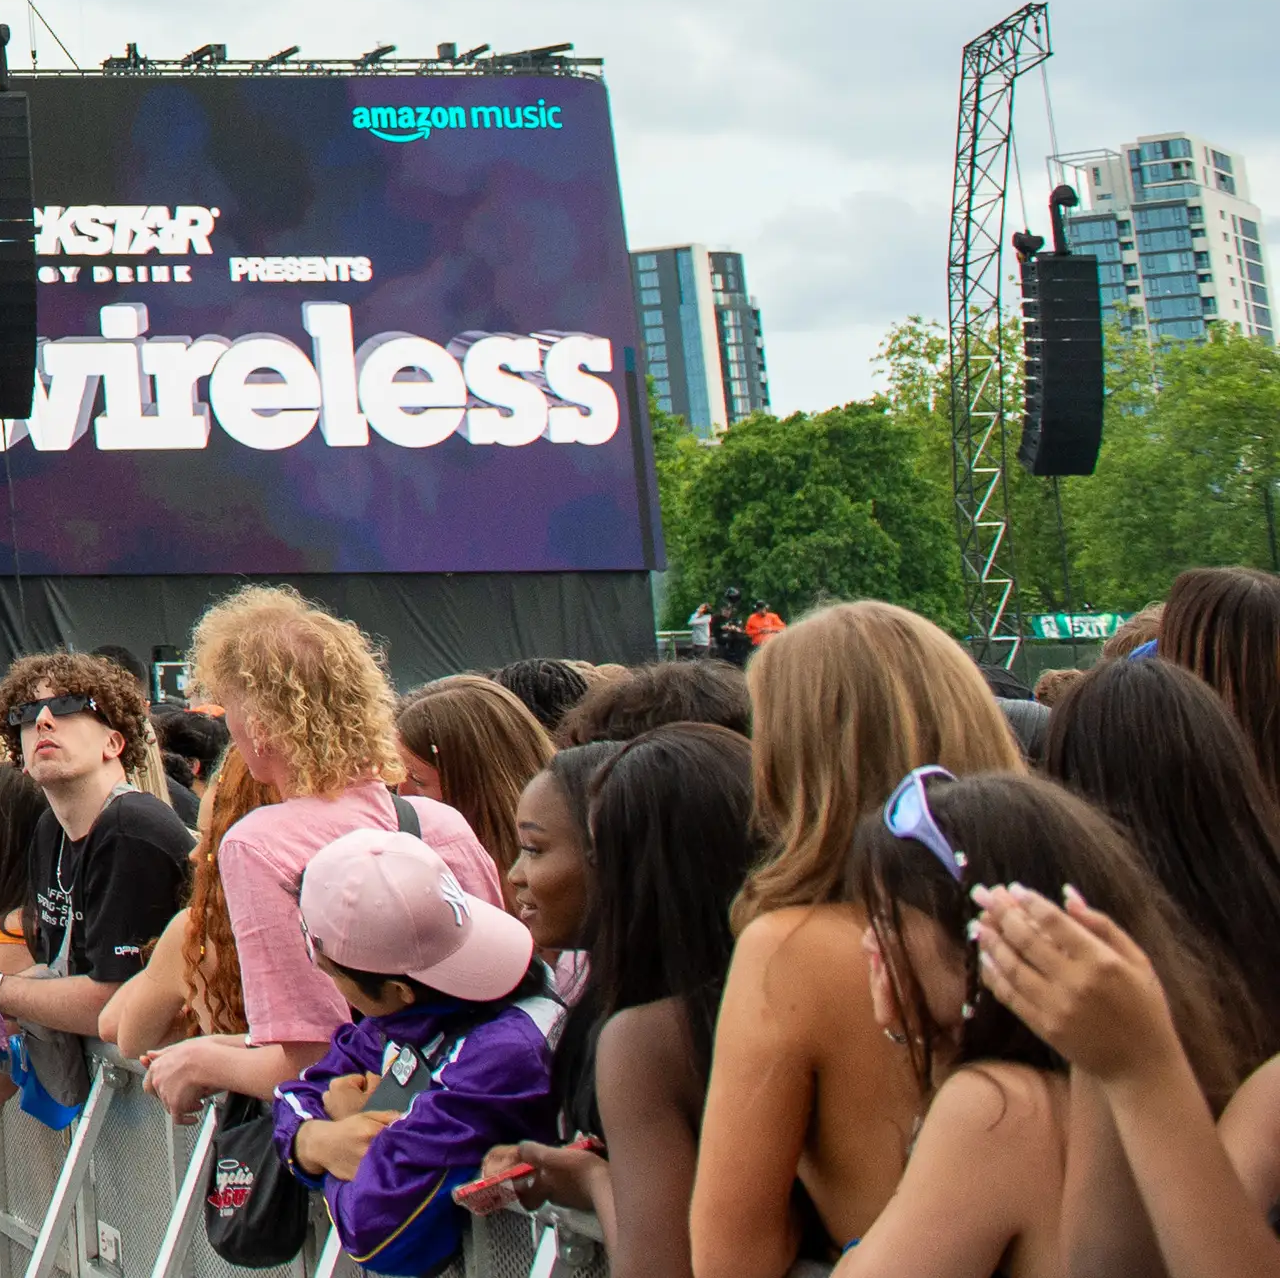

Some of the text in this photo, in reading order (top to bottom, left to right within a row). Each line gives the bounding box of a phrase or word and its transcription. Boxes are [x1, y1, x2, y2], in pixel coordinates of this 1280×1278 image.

[352, 98, 563, 129] amazon music
[92, 265, 192, 283] DRINK
[229, 256, 372, 282] PRESENTS
[1072, 615, 1109, 638] EXIT
